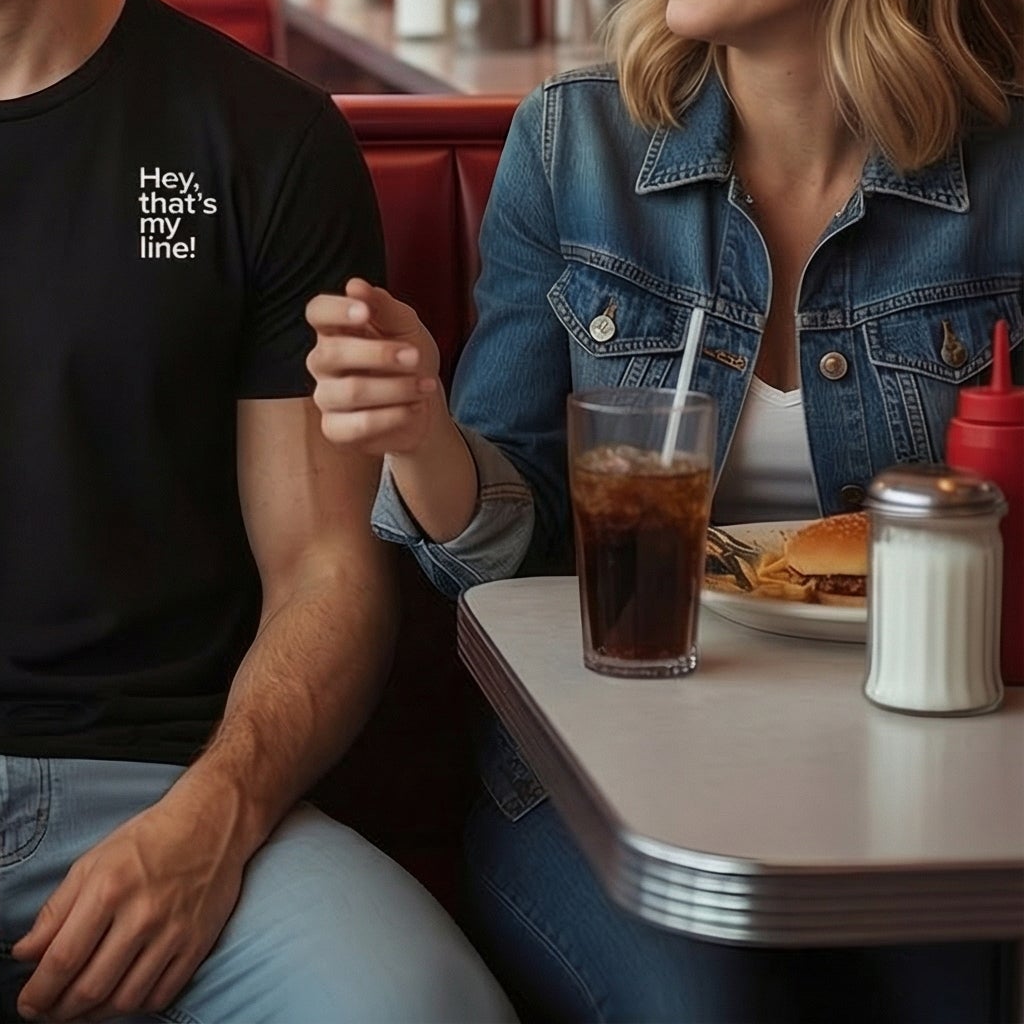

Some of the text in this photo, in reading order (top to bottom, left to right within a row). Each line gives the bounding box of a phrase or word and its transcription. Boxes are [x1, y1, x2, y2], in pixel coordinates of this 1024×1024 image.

[140, 167, 199, 194] Hey,
[138, 191, 217, 214] that's
[140, 217, 181, 240] my
[140, 236, 195, 259] line!
